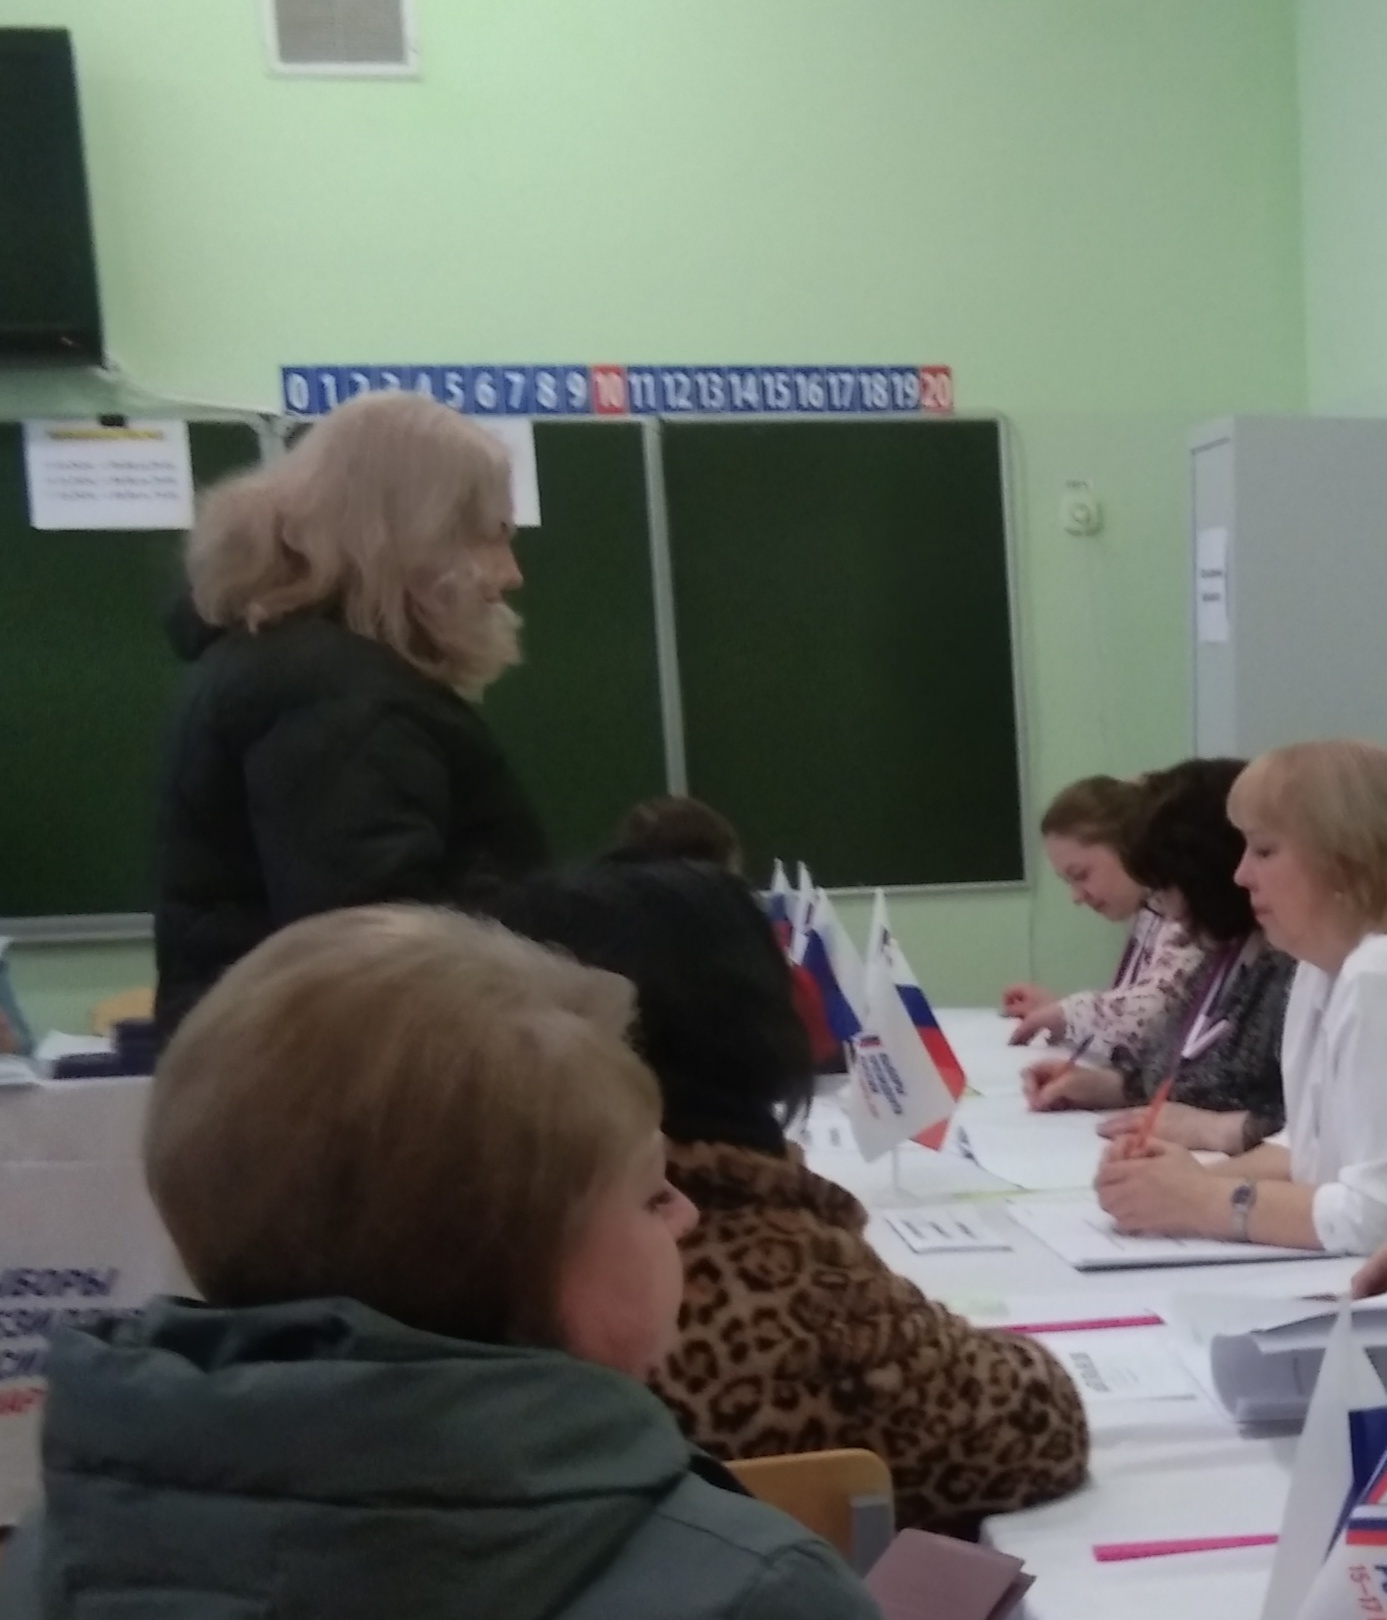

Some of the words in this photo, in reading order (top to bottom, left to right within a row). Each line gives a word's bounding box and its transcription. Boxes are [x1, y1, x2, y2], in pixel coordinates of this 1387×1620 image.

[287, 371, 310, 411] 0
[475, 371, 496, 411] 6
[536, 371, 557, 411] 8
[566, 371, 587, 411] 9
